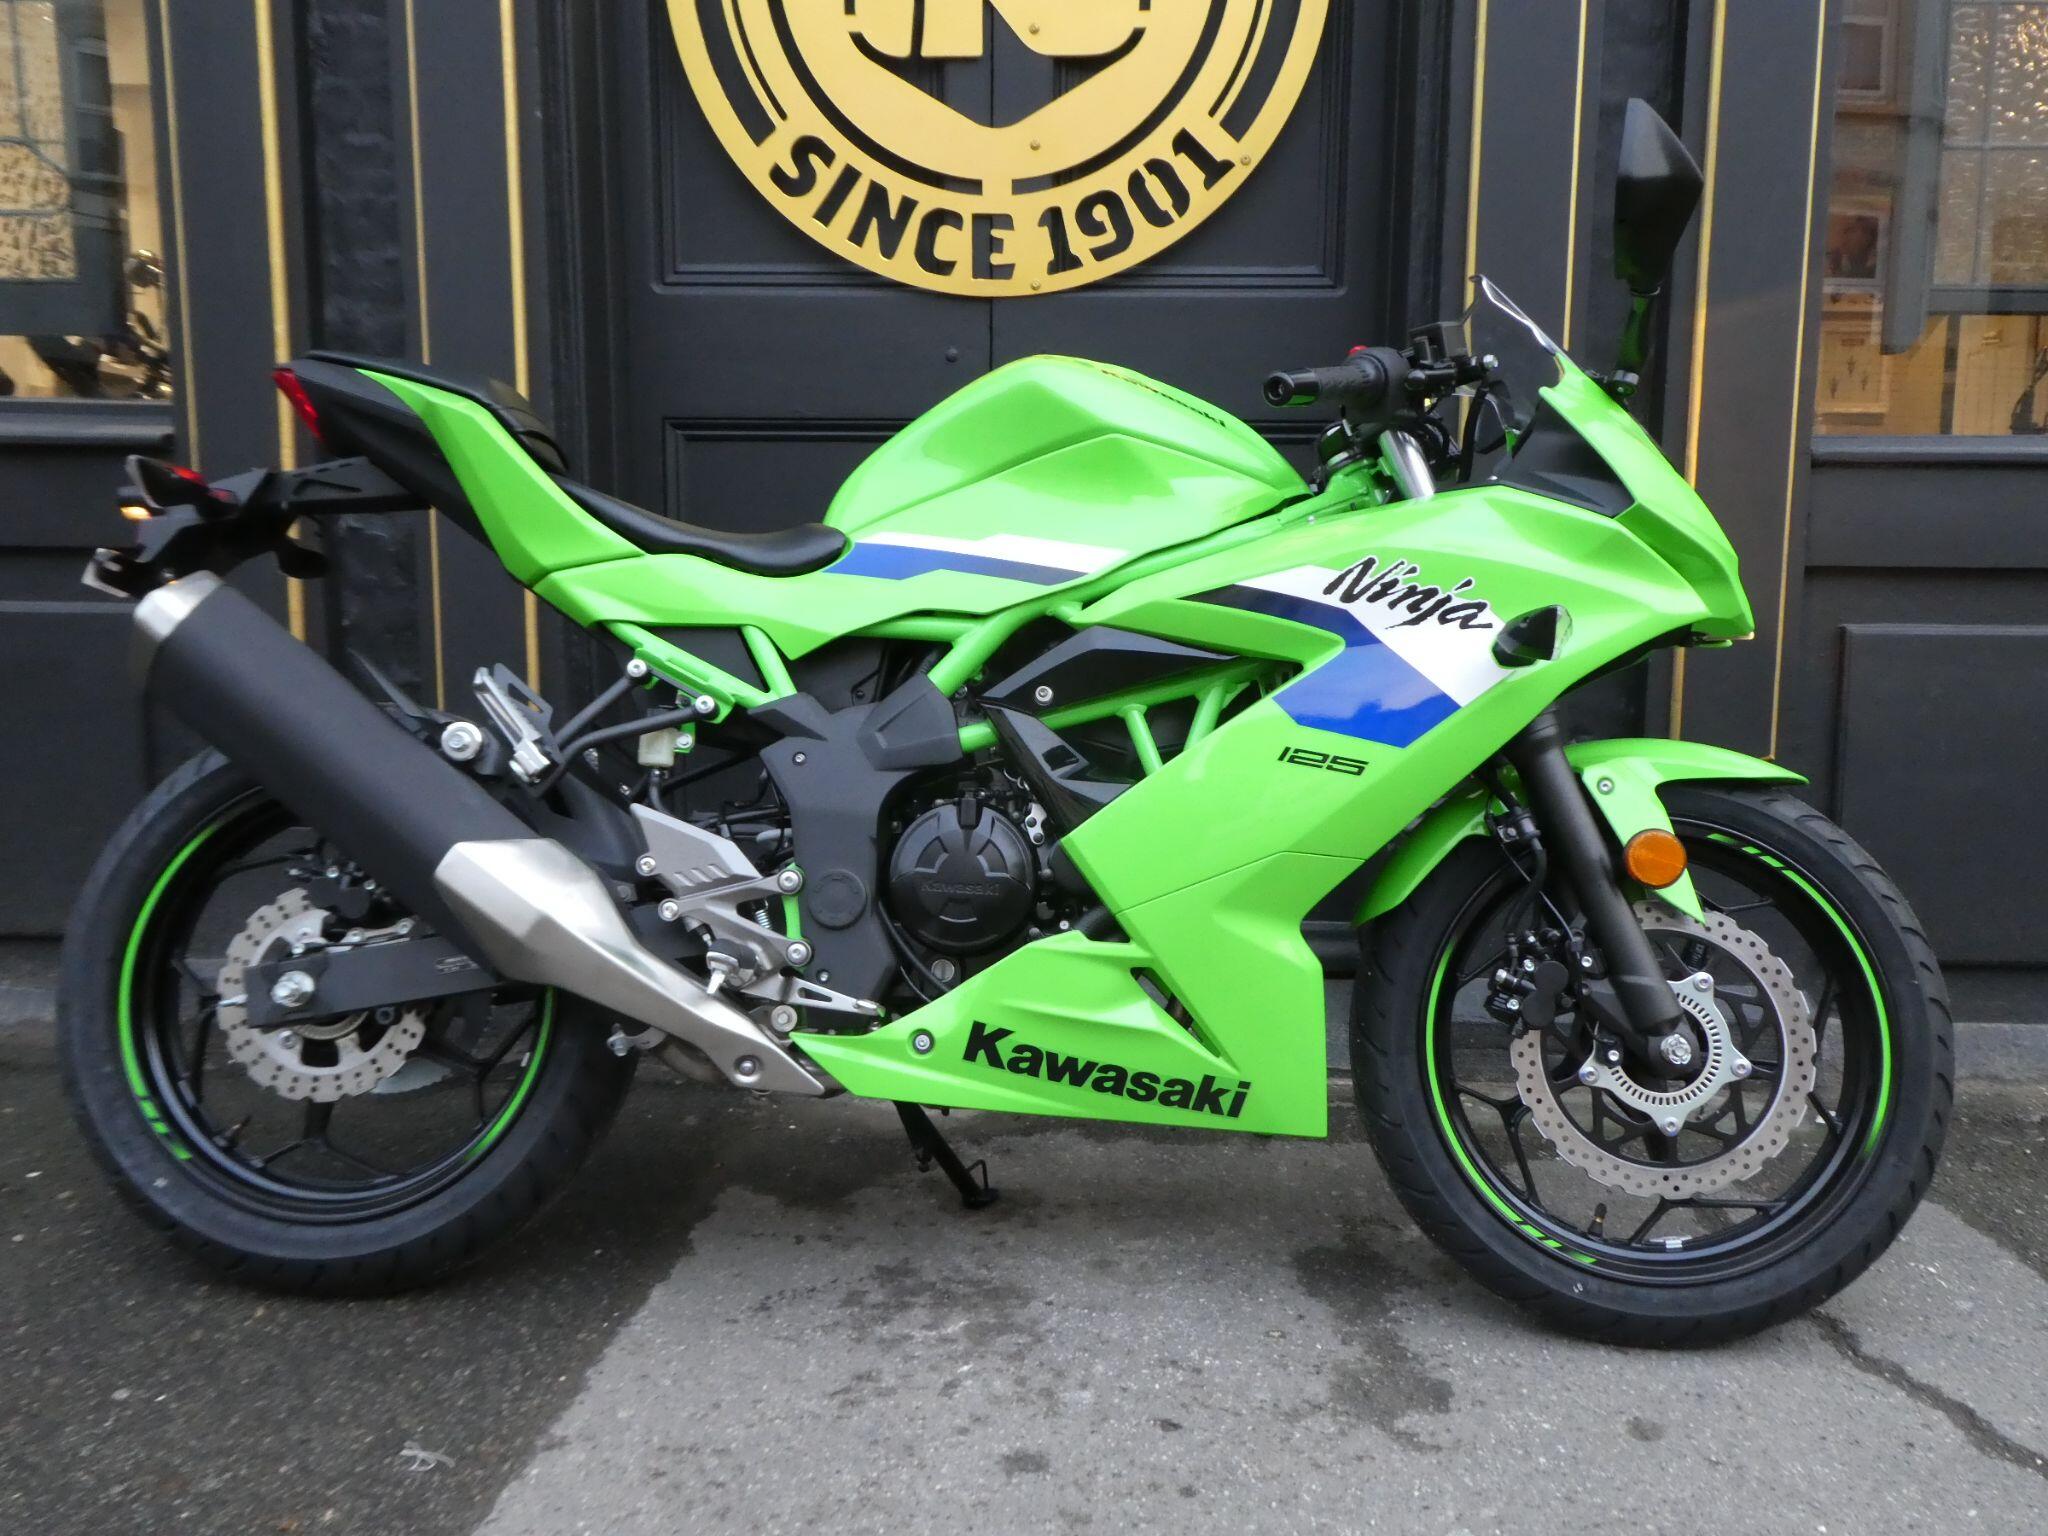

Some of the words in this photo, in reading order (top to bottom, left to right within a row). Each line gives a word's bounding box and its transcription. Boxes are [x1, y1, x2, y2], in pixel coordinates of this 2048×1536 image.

[769, 135, 1015, 280] SINCE
[1038, 127, 1235, 275] 1901
[1323, 556, 1494, 630] Ninja
[1277, 746, 1369, 777] 125
[962, 1020, 1251, 1119] Kawasaki
